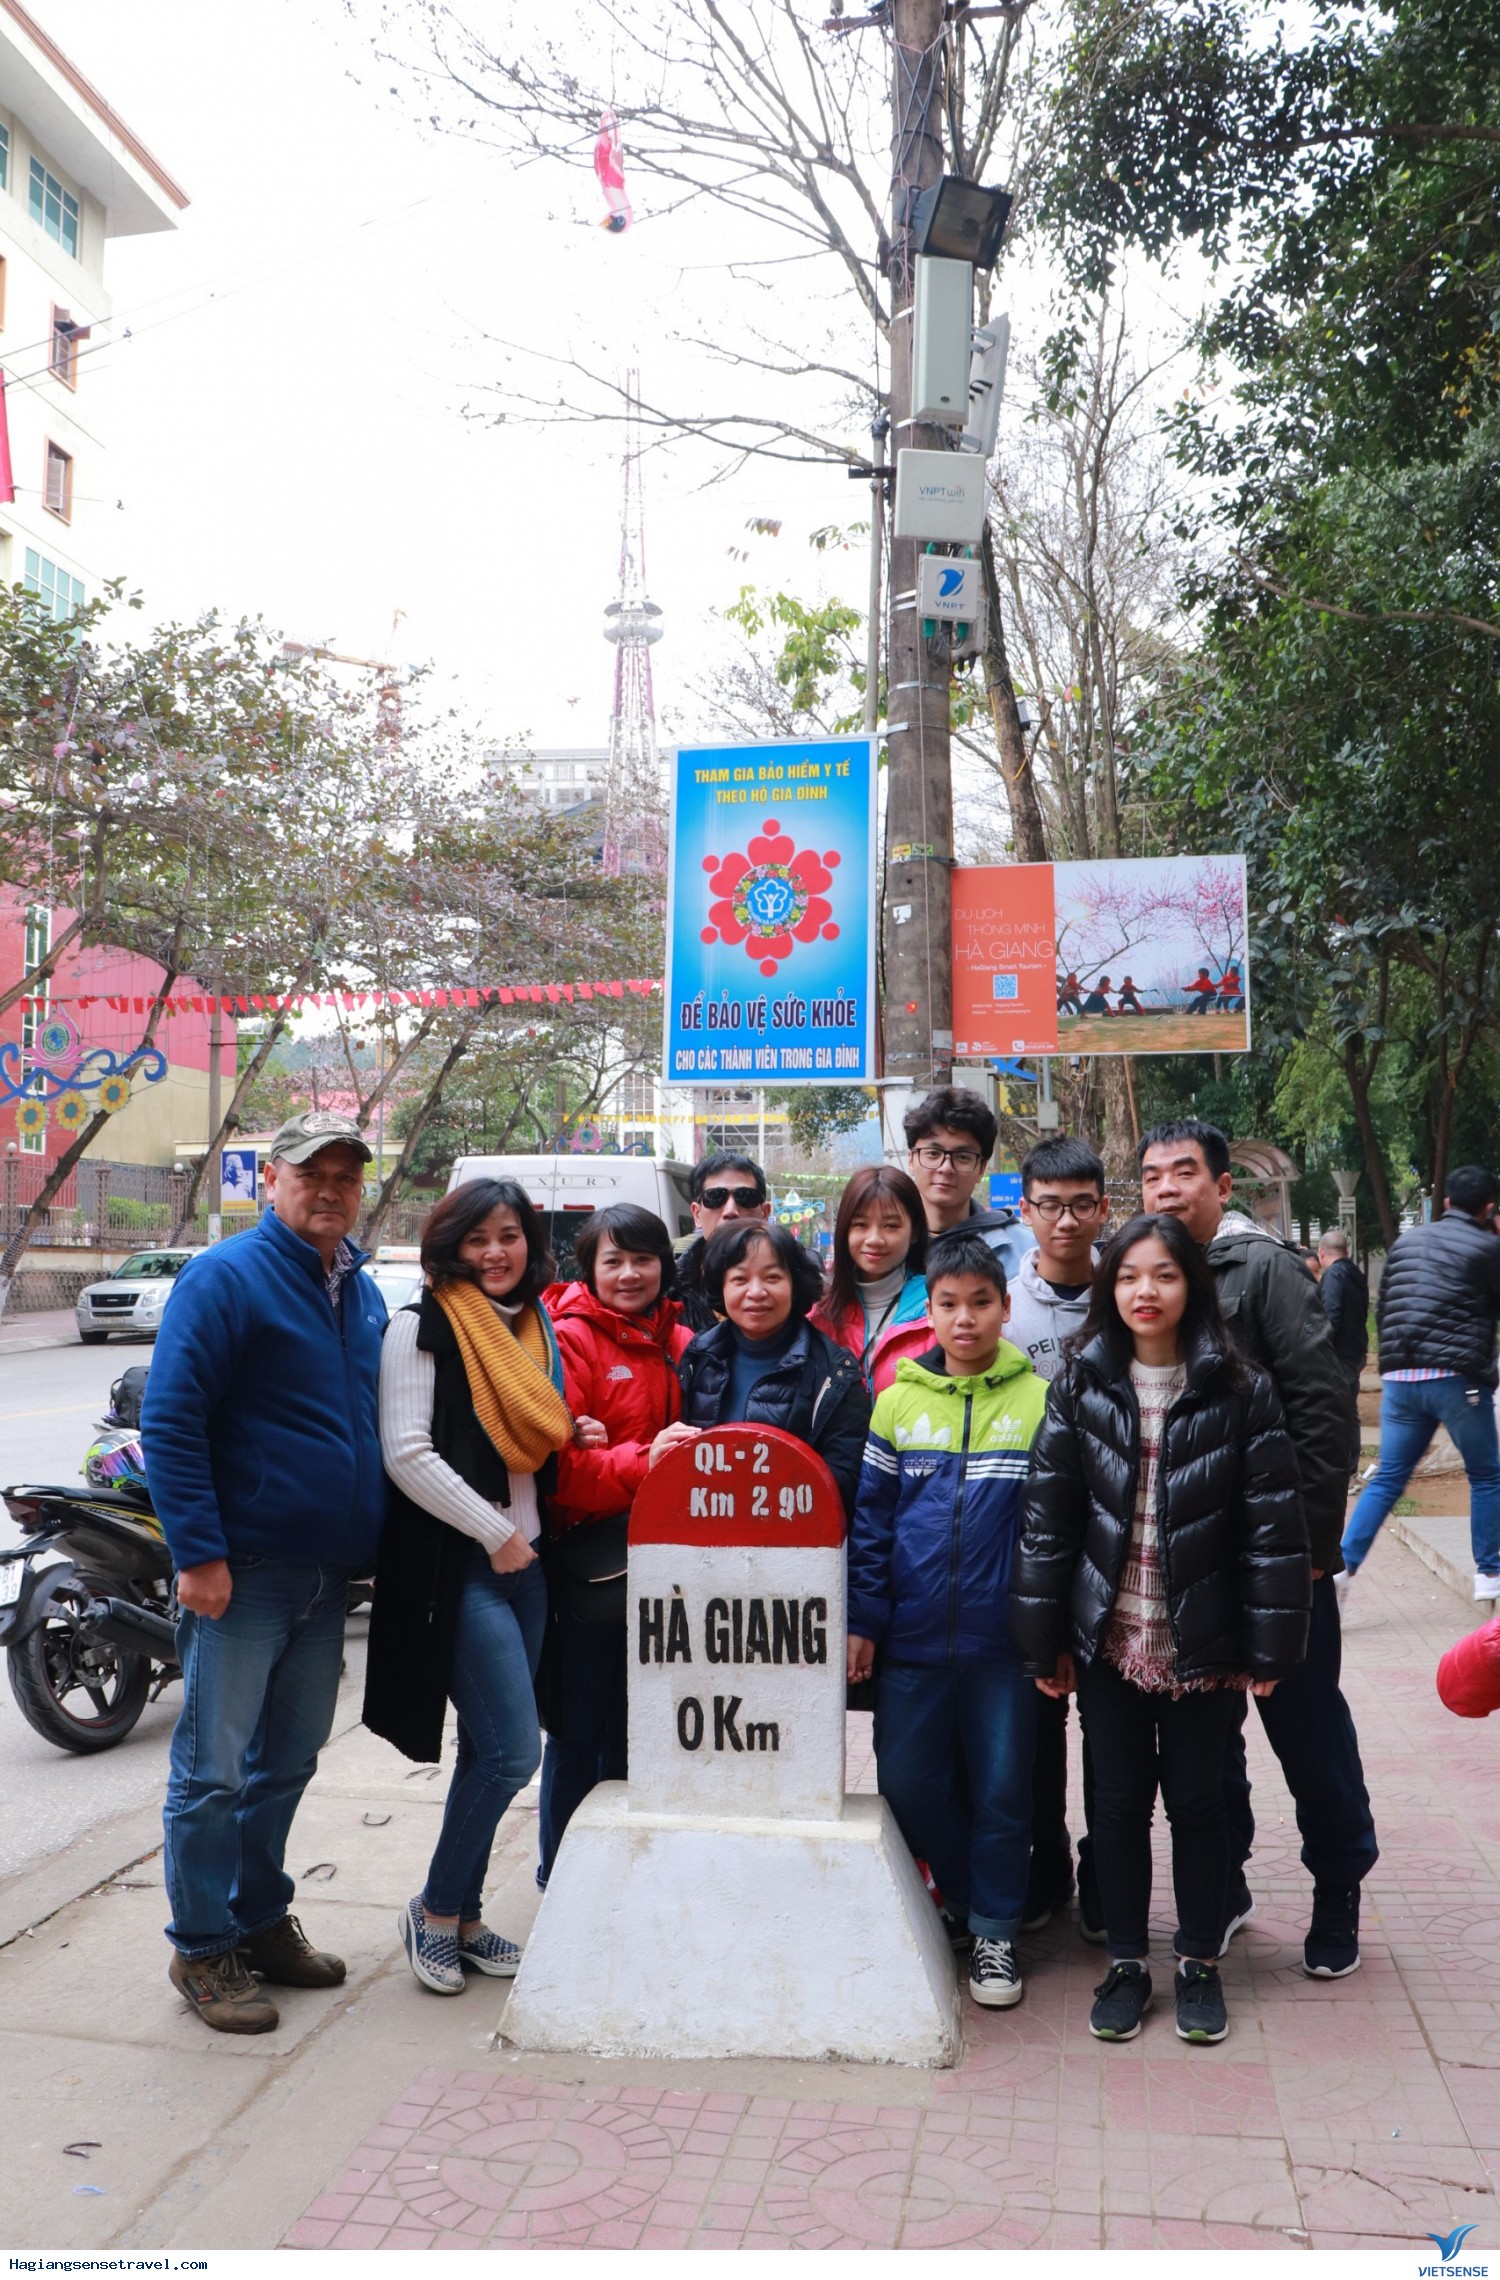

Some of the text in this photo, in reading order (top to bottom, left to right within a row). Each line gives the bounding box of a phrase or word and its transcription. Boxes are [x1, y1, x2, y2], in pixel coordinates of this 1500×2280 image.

[935, 601, 965, 610] VNPT
[695, 757, 851, 783] THAM GIA BẢO HIỂM Y TẾ
[716, 784, 828, 804] THEO HỘ GIA ĐÌNH
[954, 908, 973, 920] DU
[966, 922, 1046, 936] THÔNG MINH
[955, 939, 1054, 960] HÀ GIANG
[680, 988, 857, 1035] ĐỂ BẢO VỆ SỨC KHỎE
[675, 1043, 860, 1071] CHO CÁC THÀNH VIÊN TRONG GIA ĐÌNH
[690, 1487, 735, 1518] Km
[638, 1583, 828, 1665] HÀ GIANG
